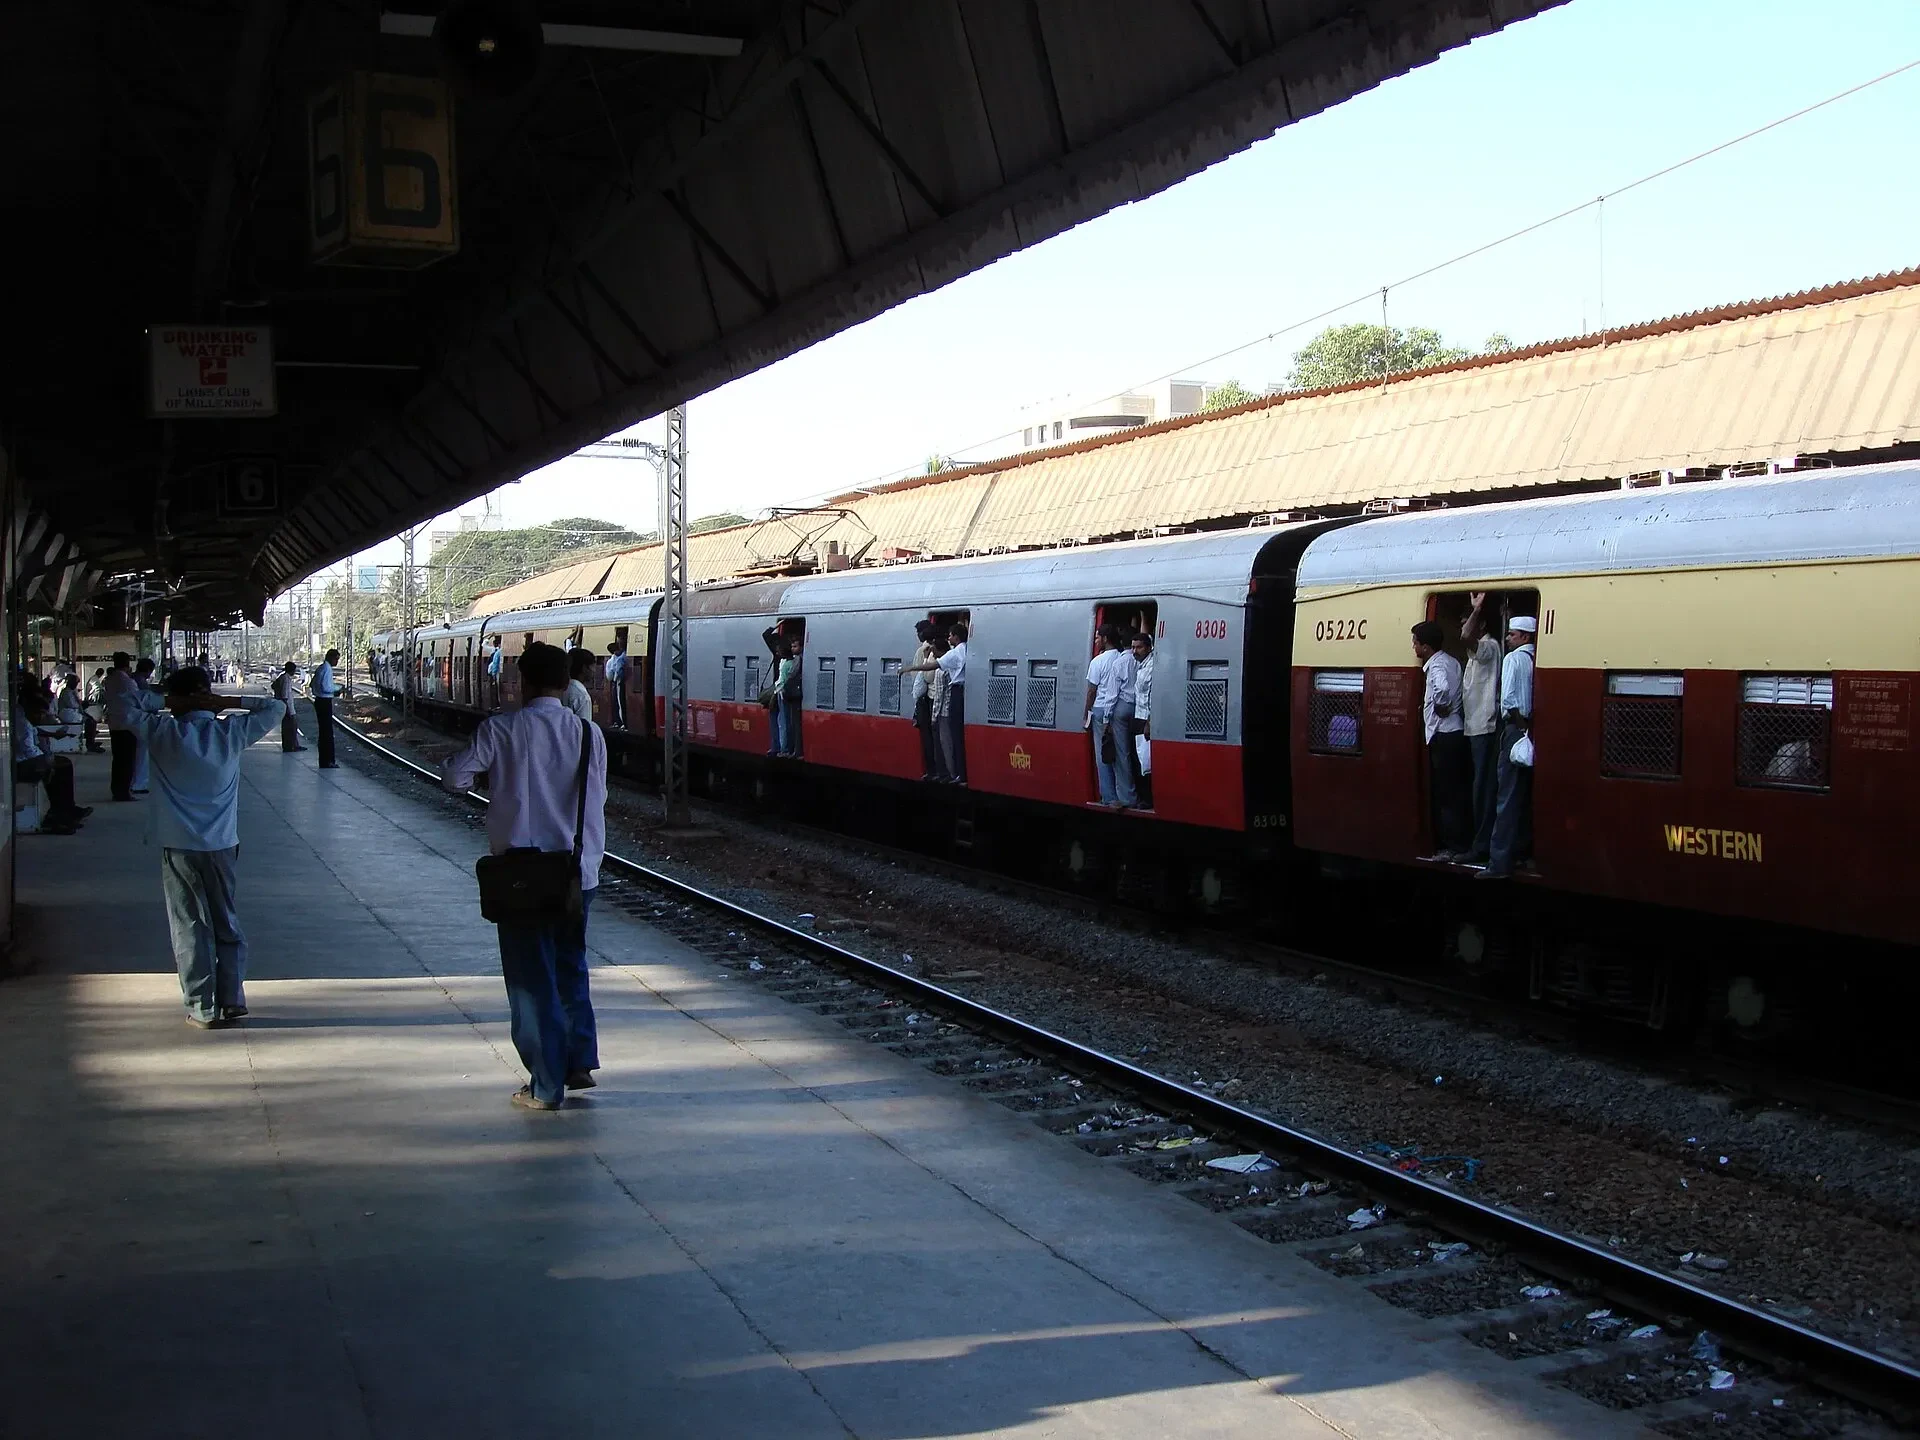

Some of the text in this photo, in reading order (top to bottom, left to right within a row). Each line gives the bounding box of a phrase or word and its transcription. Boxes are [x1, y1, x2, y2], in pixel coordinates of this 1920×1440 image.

[365, 93, 441, 228] 6
[163, 331, 258, 344] DRINKING
[179, 344, 246, 357] WATER
[240, 465, 264, 502] 6
[1196, 619, 1226, 640] 830B
[1316, 619, 1368, 642] 0522C
[1664, 824, 1763, 863] WESTERN
